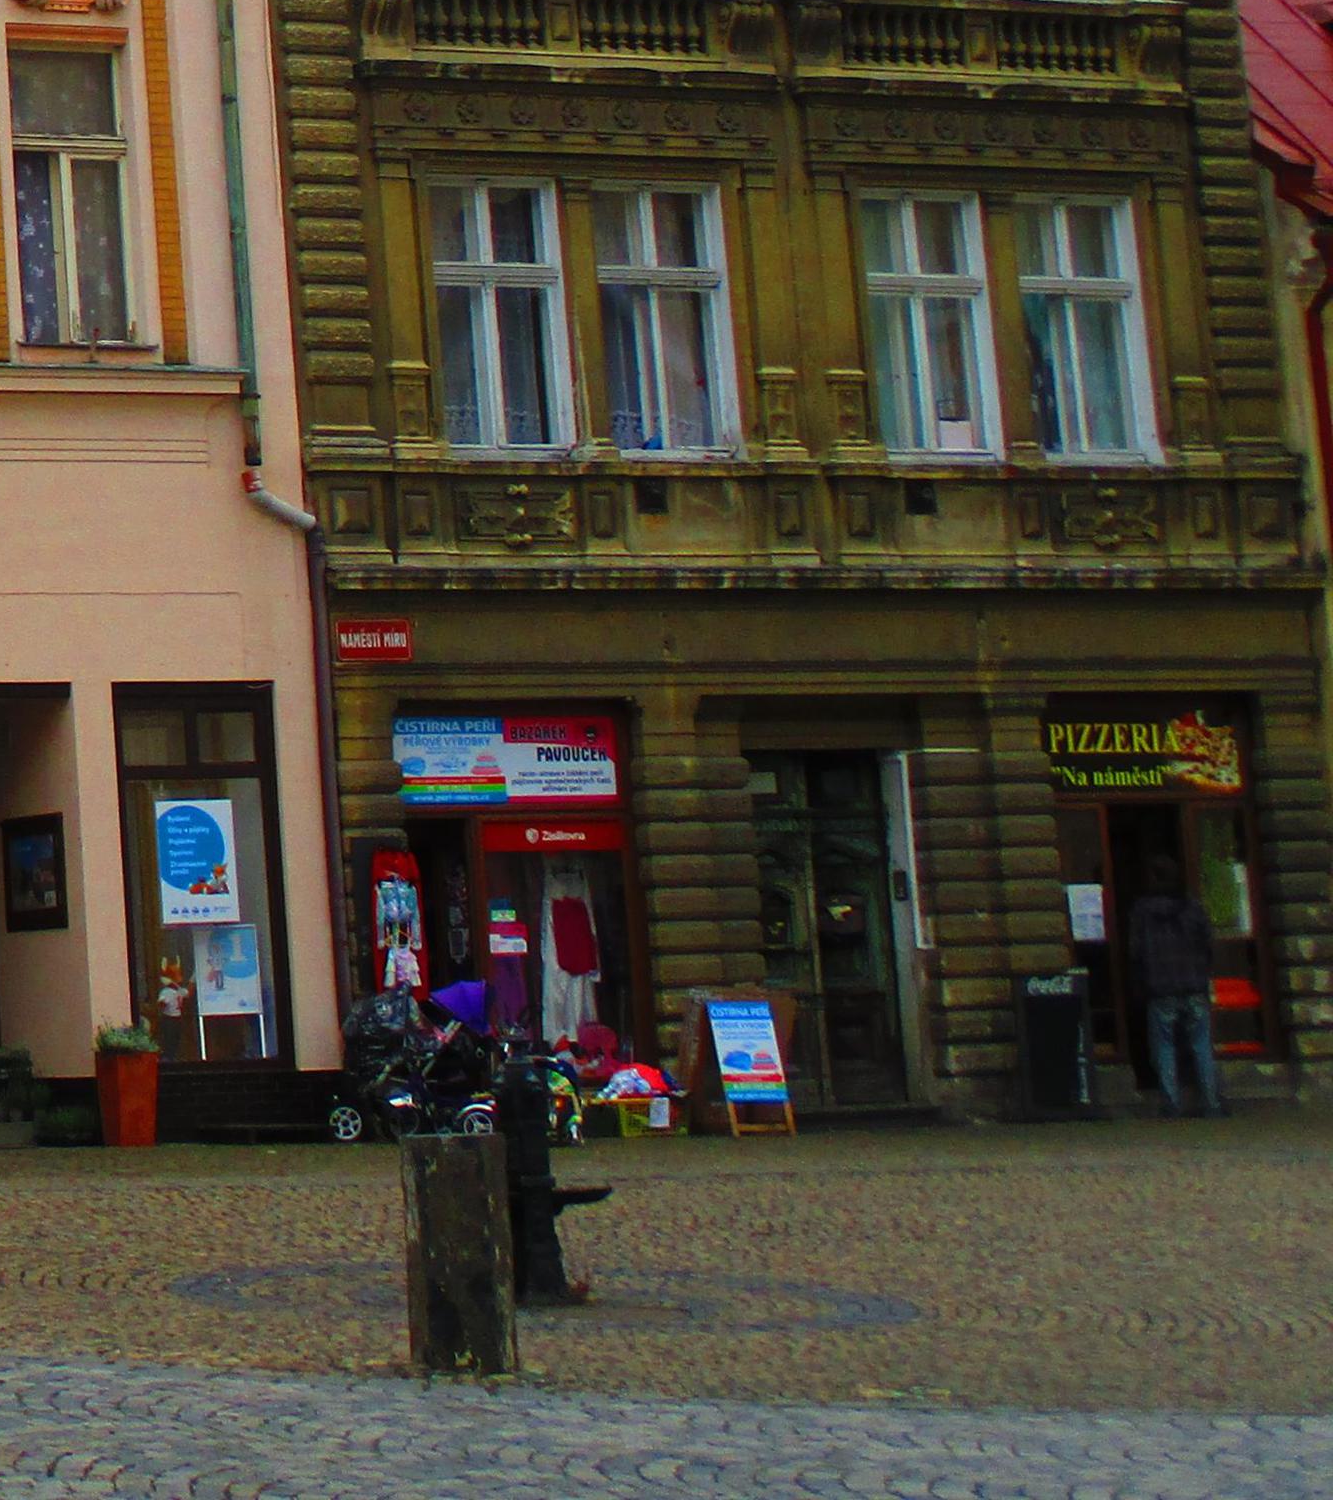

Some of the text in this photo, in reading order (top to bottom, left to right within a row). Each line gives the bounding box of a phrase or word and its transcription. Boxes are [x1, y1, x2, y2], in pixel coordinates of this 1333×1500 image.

[340, 627, 407, 648] NÁMĚSTÍ MÍRU
[1047, 722, 1182, 754] PIZZERIA
